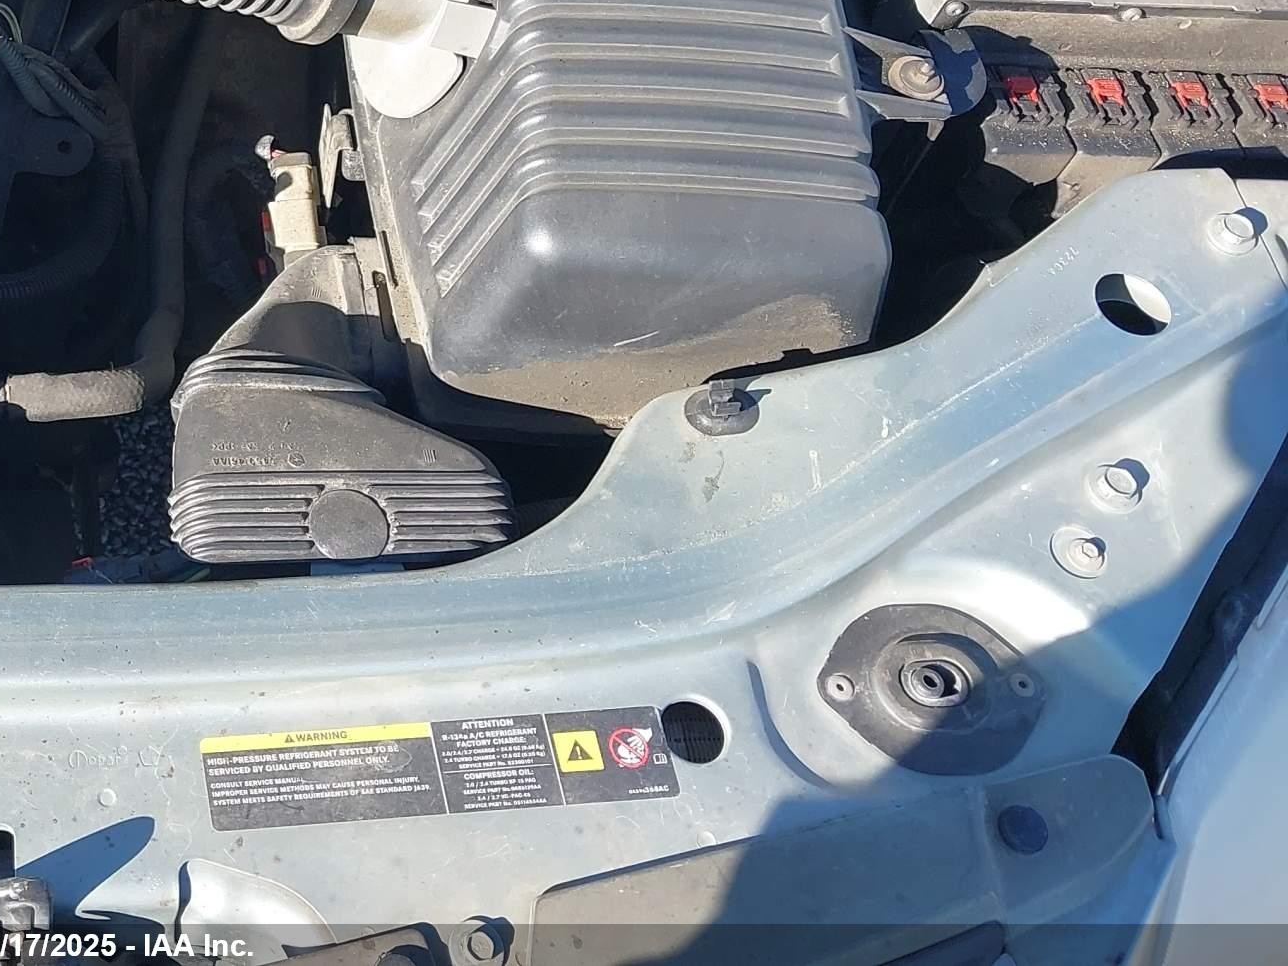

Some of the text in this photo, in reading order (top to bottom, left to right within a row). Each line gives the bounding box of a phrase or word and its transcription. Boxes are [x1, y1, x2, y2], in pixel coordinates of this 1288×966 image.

[462, 718, 514, 730] ATTENTION
[296, 731, 348, 742] WARNING
[470, 732, 484, 740] A/C
[486, 728, 537, 738] REFRIGERANT
[456, 736, 527, 748] FACTORY CHARGE:
[207, 744, 400, 766] HIGH-PRESSURE REFRIGERANT SYSTEM TO BE
[208, 756, 390, 777] SERVICED BY QUALIFIED PERSONNEL ONLY.
[464, 768, 534, 780] COMPRESSOR OIL:
[210, 780, 243, 790] CONSULT
[244, 778, 274, 788] SERVICE
[212, 788, 248, 798] IMPROPER
[250, 786, 279, 796] SERVICE
[280, 784, 314, 794] METHODS
[315, 782, 331, 791] MAY
[332, 781, 355, 790] CAUSE
[356, 778, 392, 788] PERSONAL
[213, 797, 242, 806] SYSTEM
[242, 796, 266, 804] MEETS
[266, 794, 293, 803] SAFETY
[294, 790, 349, 801] REQUIREMENTS
[376, 786, 413, 795] STANDARD
